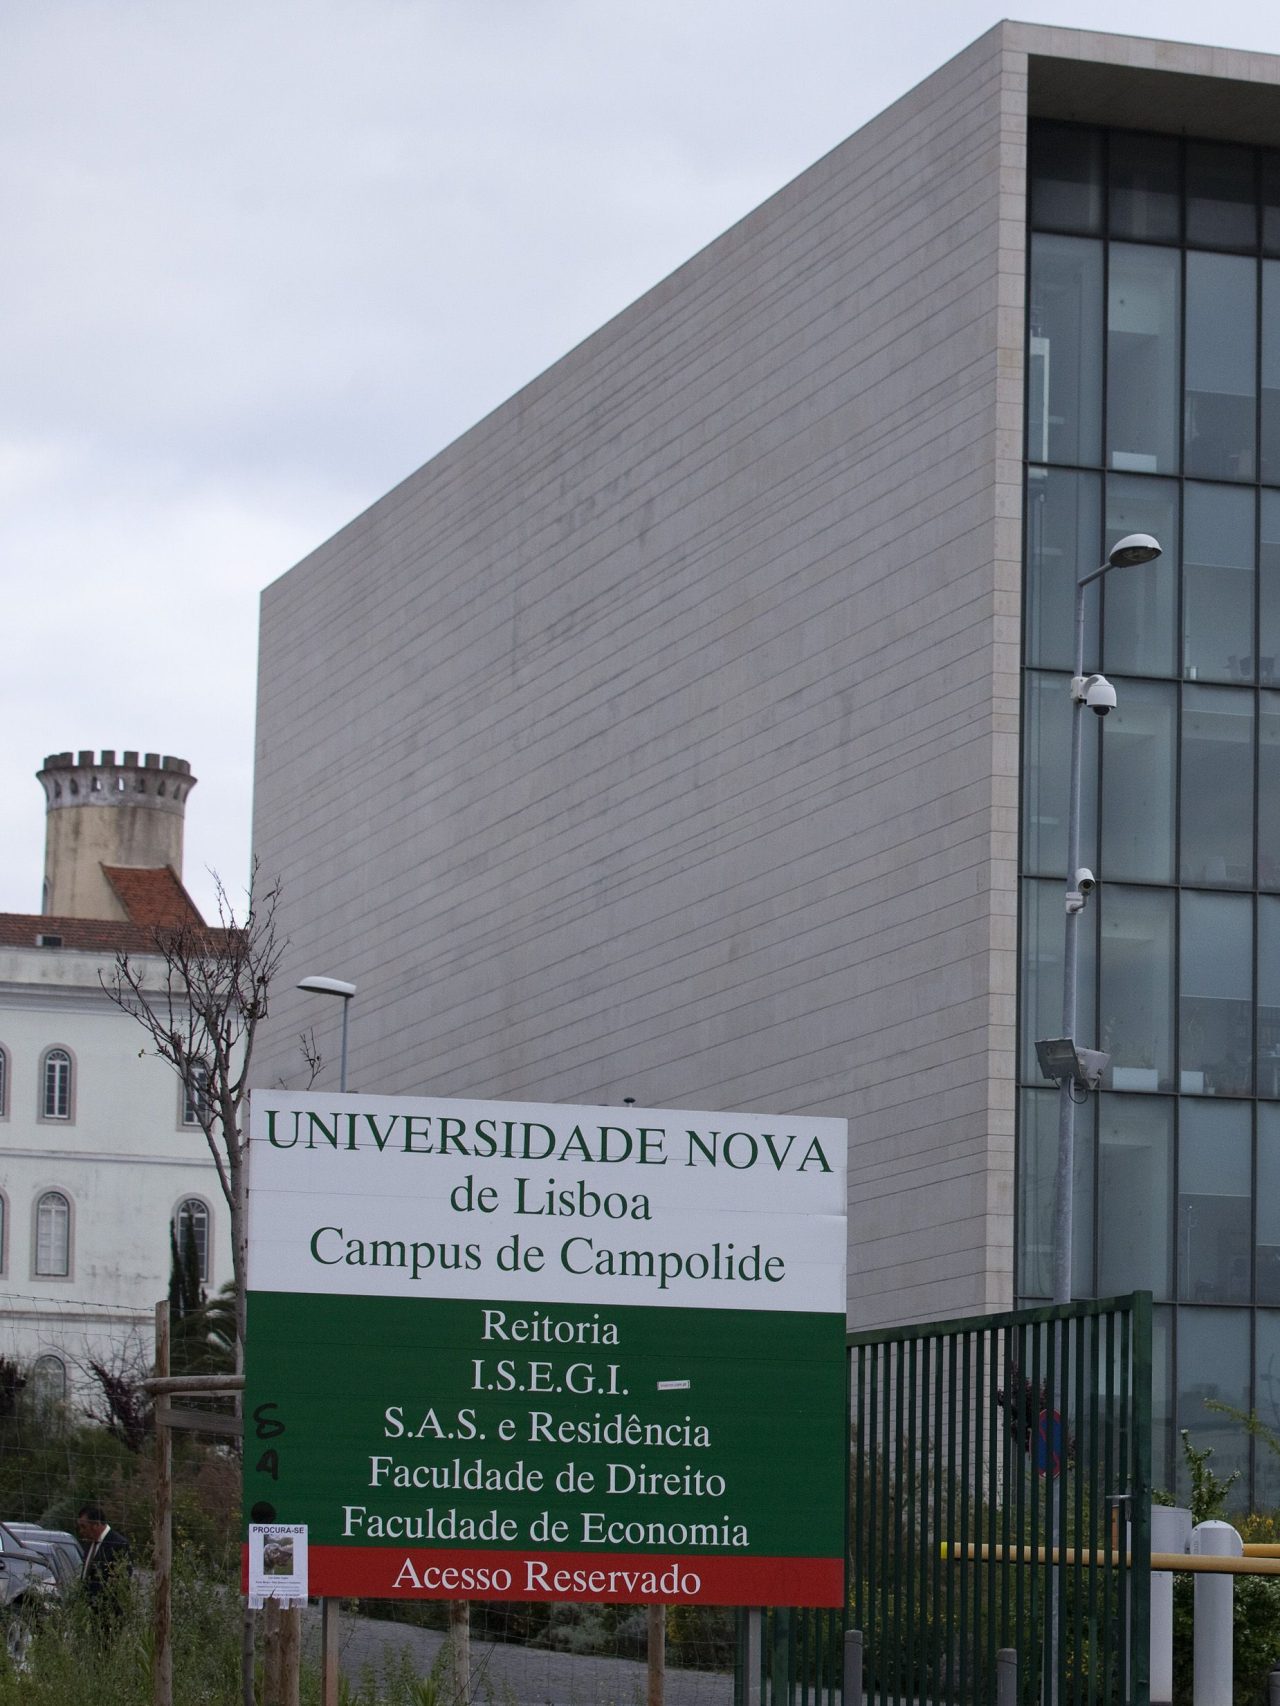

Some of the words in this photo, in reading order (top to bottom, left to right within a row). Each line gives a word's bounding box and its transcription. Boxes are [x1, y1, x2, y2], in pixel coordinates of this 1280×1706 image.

[265, 1109, 668, 1166] UNIVERSIDADE
[686, 1129, 835, 1174] NOVA
[449, 1174, 499, 1215] de
[513, 1176, 654, 1221] Lisboa
[309, 1226, 483, 1280] Campus
[495, 1233, 545, 1274] de
[559, 1236, 787, 1290] Campolide
[481, 1309, 620, 1345] Reitoria
[471, 1359, 629, 1396] I.S.E.G.I.
[384, 1406, 486, 1440] S.A.S.
[498, 1419, 517, 1441] e
[527, 1411, 712, 1448] Residência
[368, 1455, 544, 1492] Faculdade
[555, 1461, 595, 1494] de
[606, 1463, 726, 1497] Direito
[252, 1525, 305, 1534] PROCURA-SE
[341, 1505, 519, 1540] Faculdade
[529, 1510, 569, 1543] de
[580, 1512, 750, 1547] Economia
[391, 1557, 512, 1591] Acesso
[523, 1560, 701, 1595] Reservado
